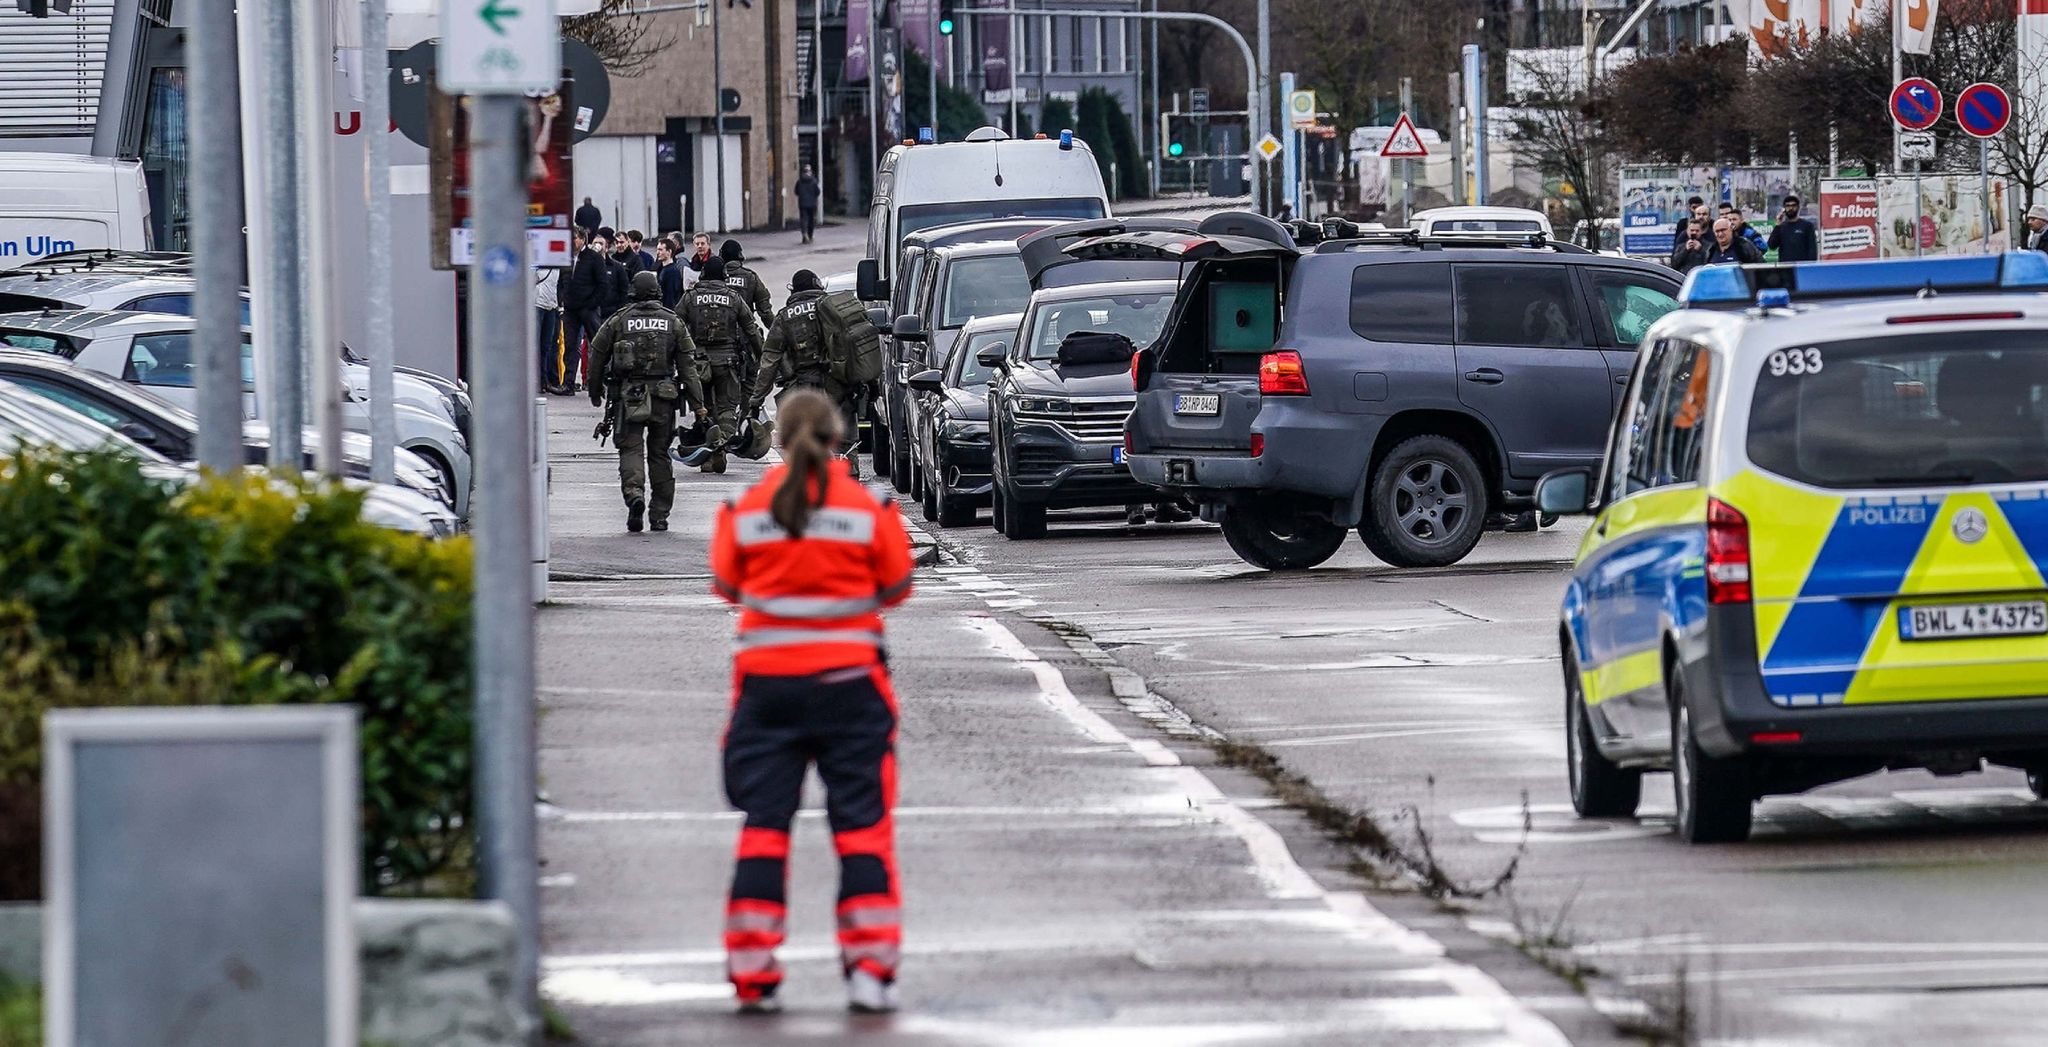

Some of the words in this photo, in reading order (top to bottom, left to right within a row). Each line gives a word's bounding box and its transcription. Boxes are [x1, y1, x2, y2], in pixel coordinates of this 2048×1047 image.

[1631, 215, 1657, 226] Kurse
[26, 236, 75, 256] Ulm
[696, 294, 730, 305] POLIZEI
[627, 318, 668, 331] POLIZEI
[1769, 347, 1823, 377] 933
[1849, 507, 1926, 526] POLIZEI
[1914, 610, 1956, 632] BWL
[1962, 608, 1973, 630] 4
[1991, 605, 2045, 628] 4375
